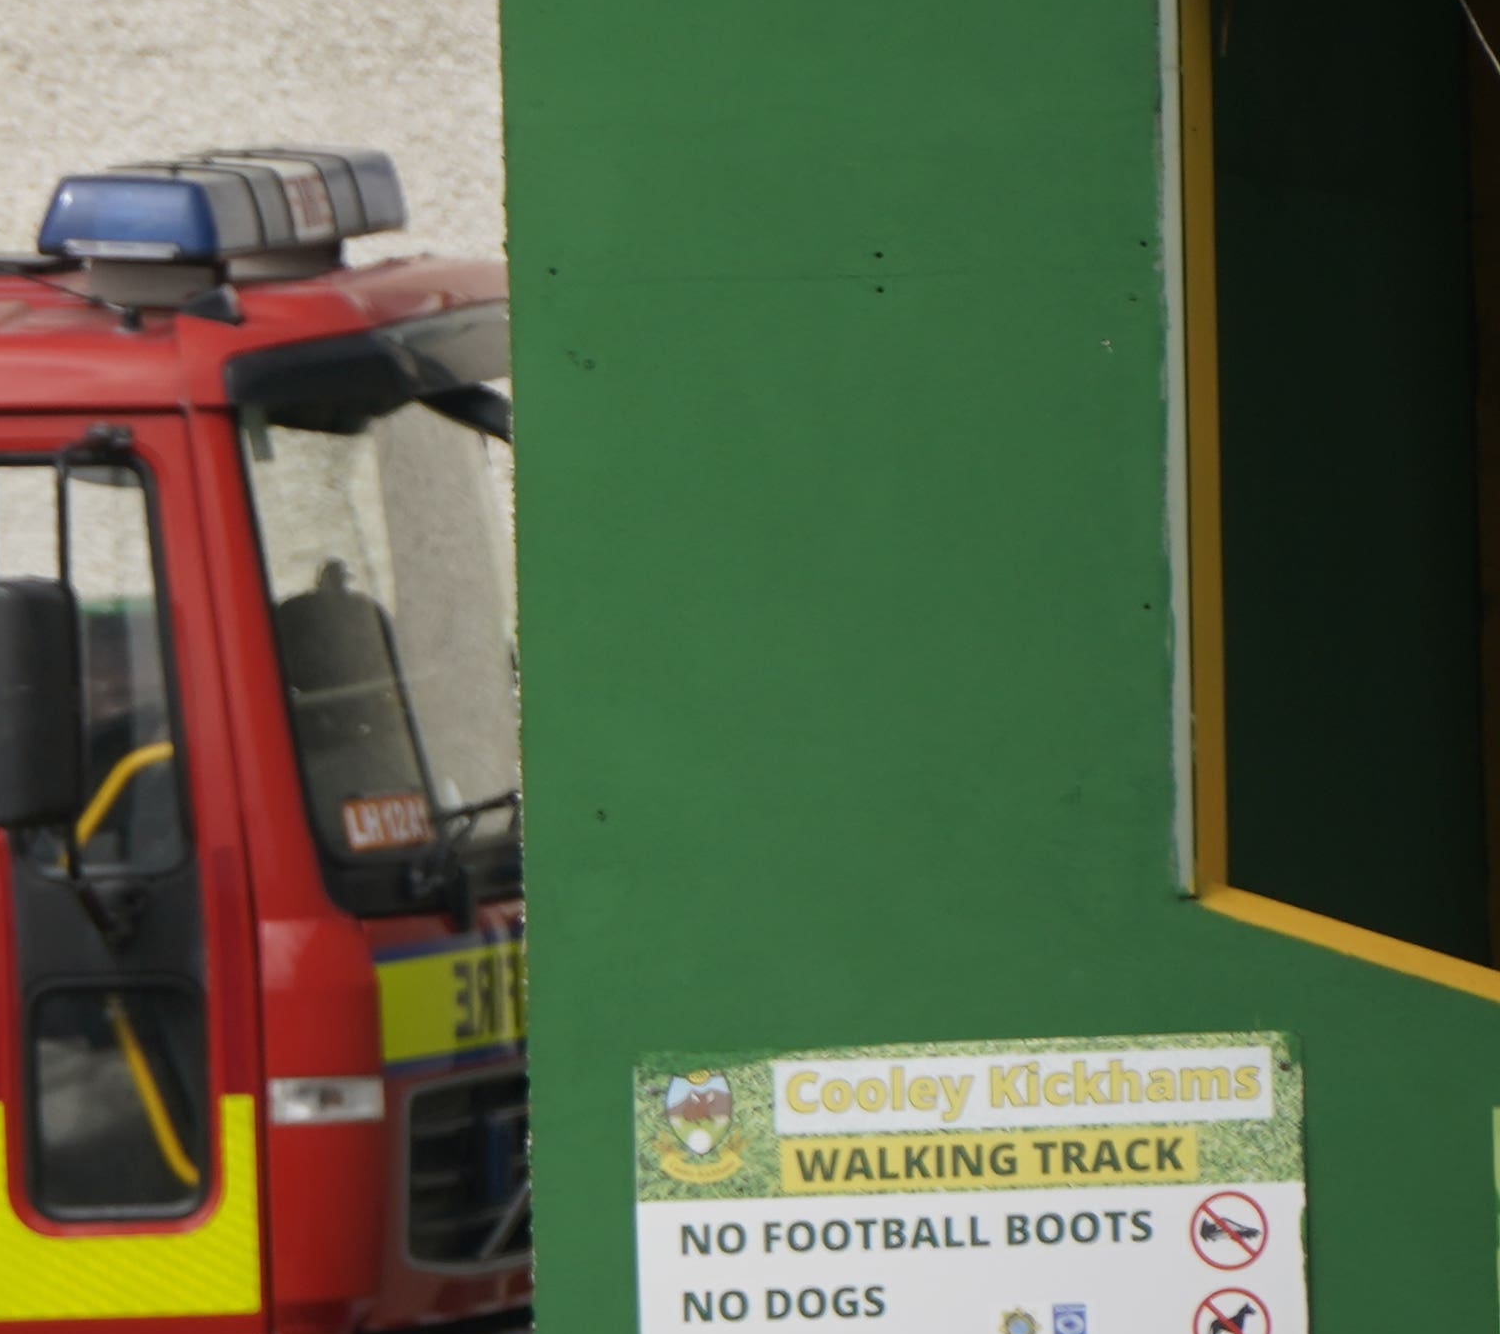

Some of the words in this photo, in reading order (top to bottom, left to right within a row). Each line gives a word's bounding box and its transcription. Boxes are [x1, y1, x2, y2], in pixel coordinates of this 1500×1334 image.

[786, 1066, 974, 1122] Cooley
[989, 1060, 1261, 1109] Kickhams
[796, 1143, 1019, 1182] WALKING
[1033, 1137, 1185, 1175] TRACK
[680, 1223, 746, 1255] NO
[763, 1216, 991, 1253] FOOTBALL
[1006, 1210, 1153, 1246] BOOTS
[683, 1289, 749, 1322] NO
[765, 1285, 886, 1320] DOGS
